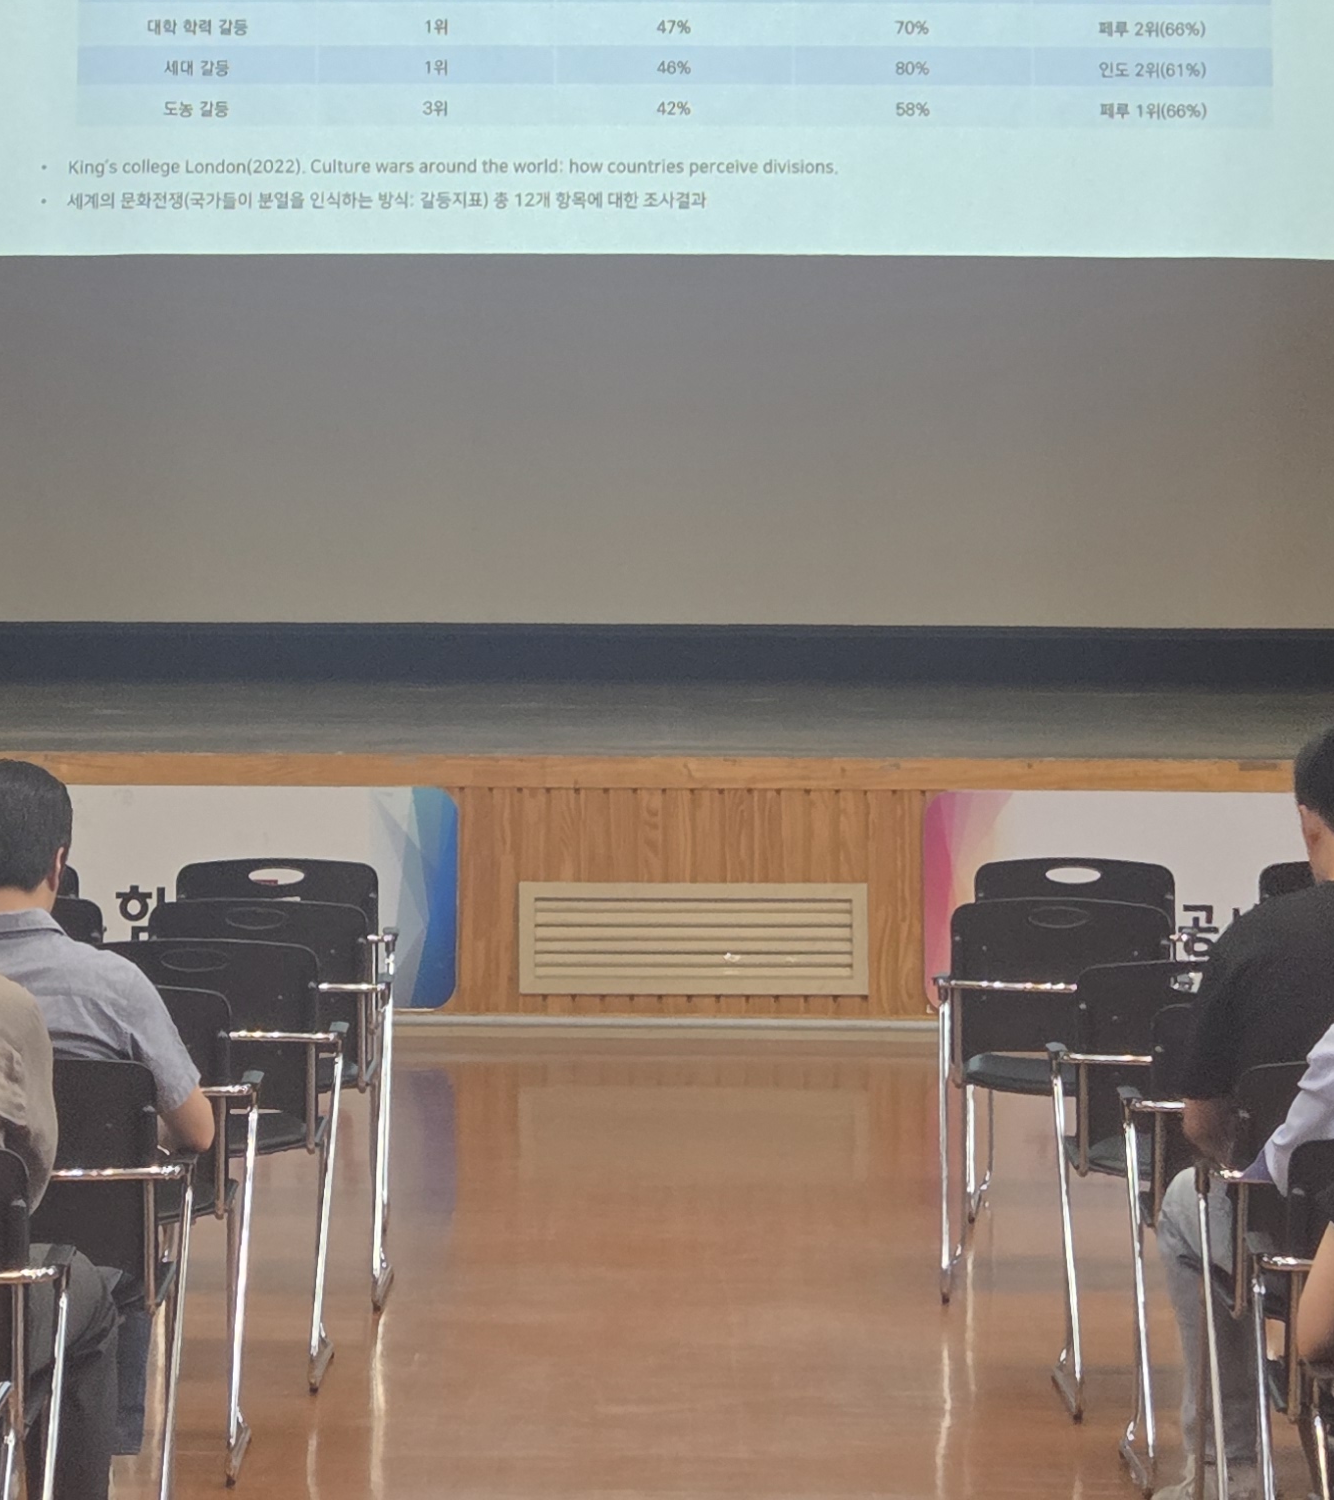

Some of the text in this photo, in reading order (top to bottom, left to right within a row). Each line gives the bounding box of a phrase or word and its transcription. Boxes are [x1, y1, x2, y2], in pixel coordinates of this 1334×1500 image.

[147, 18, 249, 37] 대학 학력 갈등
[425, 18, 449, 36] 1위
[656, 19, 692, 35] 47%
[894, 20, 930, 36] 70%
[1098, 20, 1207, 39] 페루 2위(66%)
[163, 59, 230, 78] 세대 갈등
[425, 59, 448, 77] 1위
[656, 59, 692, 75] 46%
[895, 60, 930, 76] 80%
[1098, 61, 1207, 80] 인도 2위(61%)
[163, 100, 230, 119] 도농 갈등
[422, 99, 448, 117] 3위
[656, 100, 692, 116] 42%
[895, 101, 931, 118] 58%
[1099, 102, 1208, 121] 페루 1위(66%)
[122, 158, 181, 178] college
[185, 157, 306, 177] London(2022).
[310, 158, 371, 174] Culture
[375, 161, 415, 174] wars
[418, 158, 478, 174] around
[481, 157, 509, 174] the
[512, 158, 563, 174] world:
[569, 157, 604, 174] how
[607, 158, 685, 174] countries
[689, 159, 759, 178] perceive
[762, 158, 838, 175] divisions.
[66, 190, 707, 211] 세계의 문화전쟁(국가들이 분열을 인식하는 방식: 갈등지표) 총 12개 항목에 대한 조사결과
